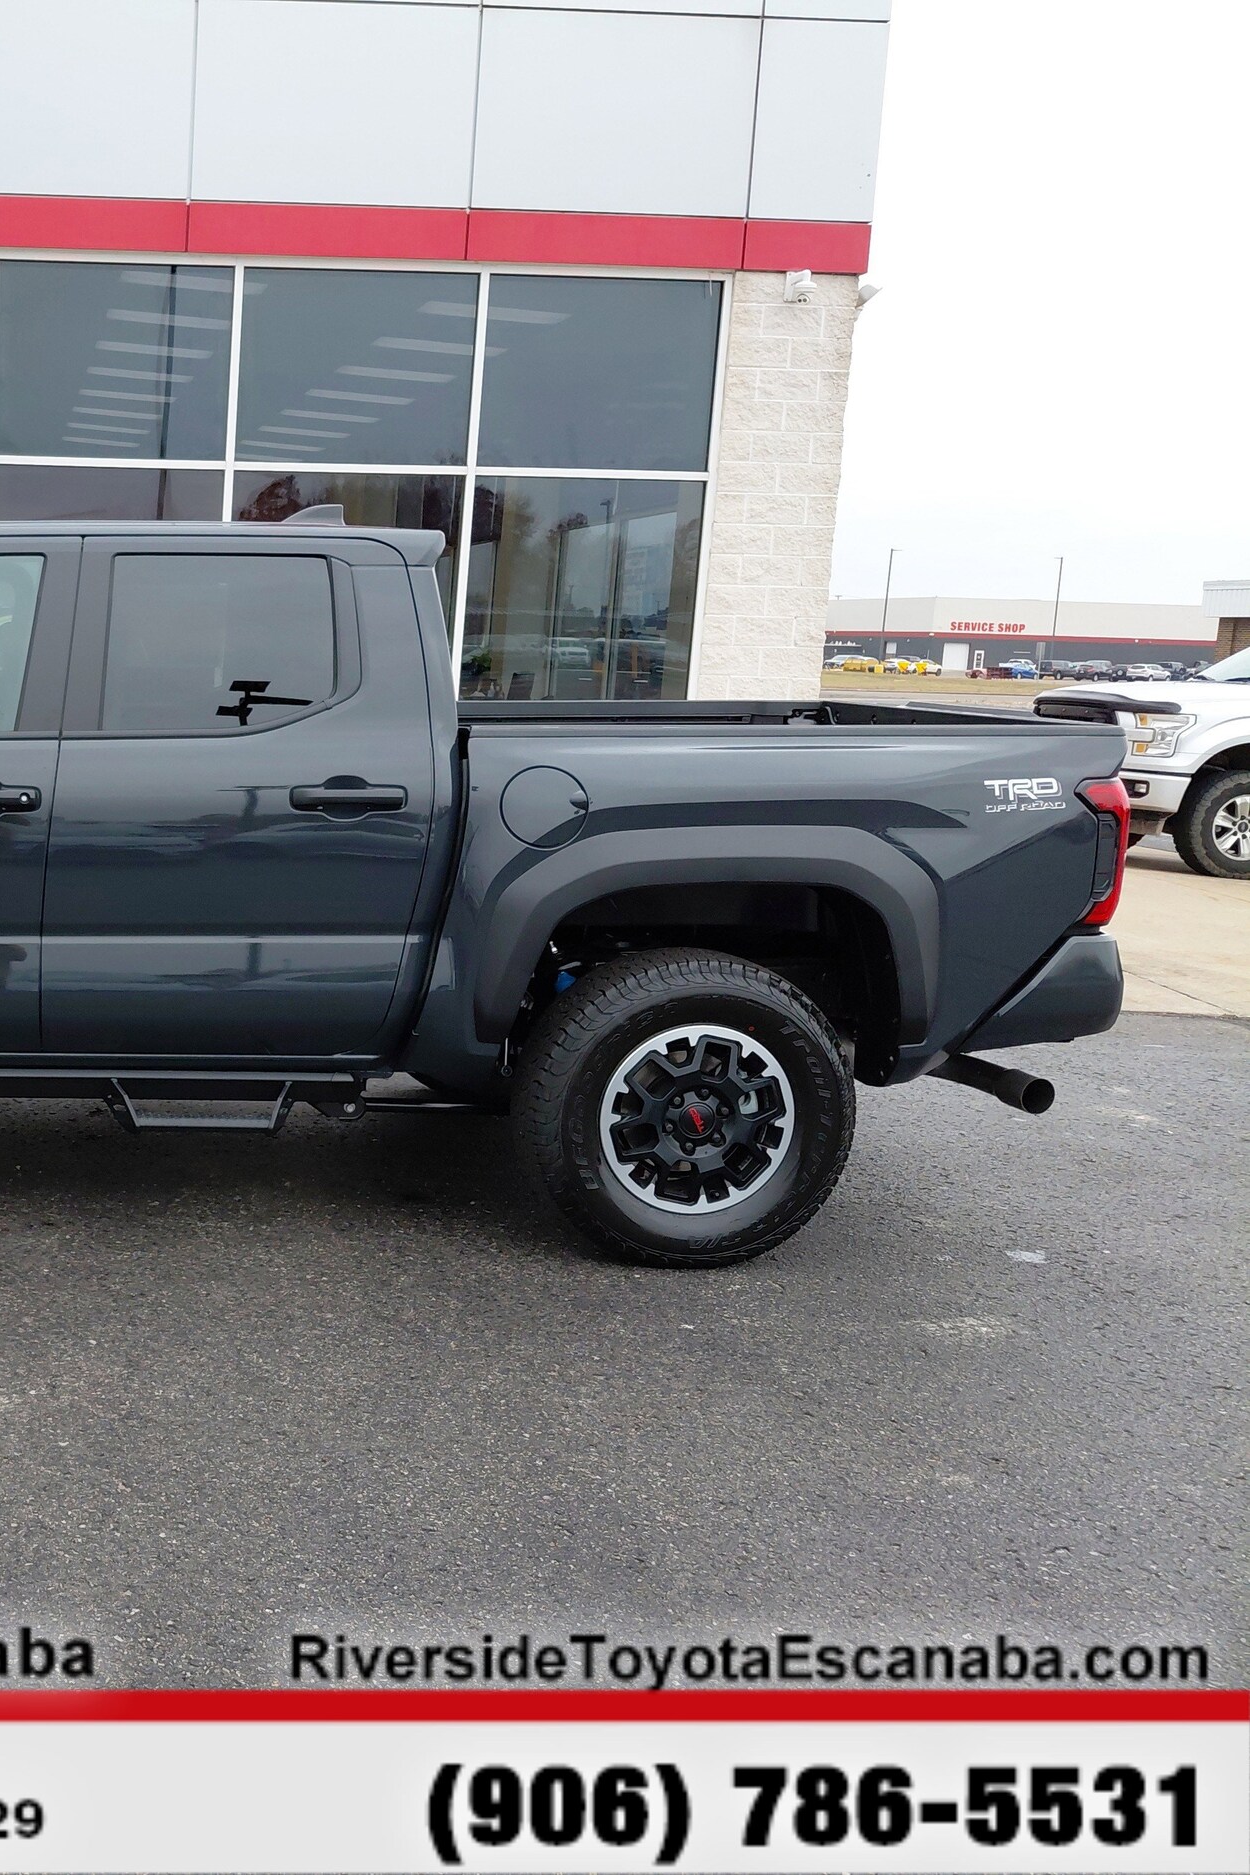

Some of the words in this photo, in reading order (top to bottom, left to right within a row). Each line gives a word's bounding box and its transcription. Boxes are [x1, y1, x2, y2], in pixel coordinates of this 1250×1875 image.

[950, 621, 995, 632] SERVICE
[998, 622, 1026, 633] SHOP
[983, 777, 1062, 802] TRD
[985, 803, 1017, 813] OFF
[1020, 800, 1066, 812] ROAD
